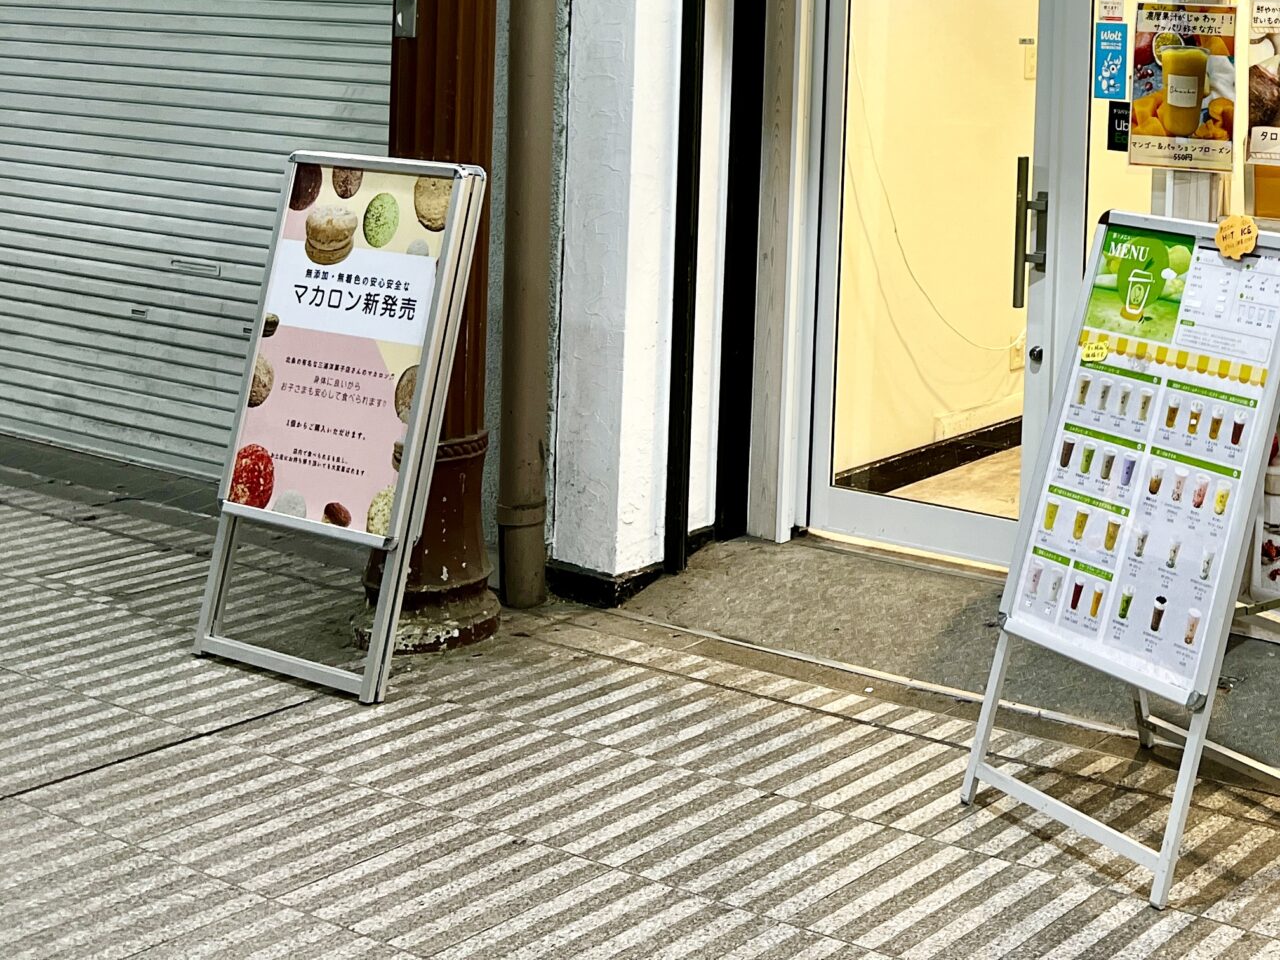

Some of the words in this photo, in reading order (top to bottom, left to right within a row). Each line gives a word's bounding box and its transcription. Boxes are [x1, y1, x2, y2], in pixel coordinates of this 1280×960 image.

[1101, 30, 1122, 41] Wolt
[1115, 119, 1129, 131] Ub
[1108, 241, 1150, 262] MENU
[294, 284, 417, 321] マカロン新発売
